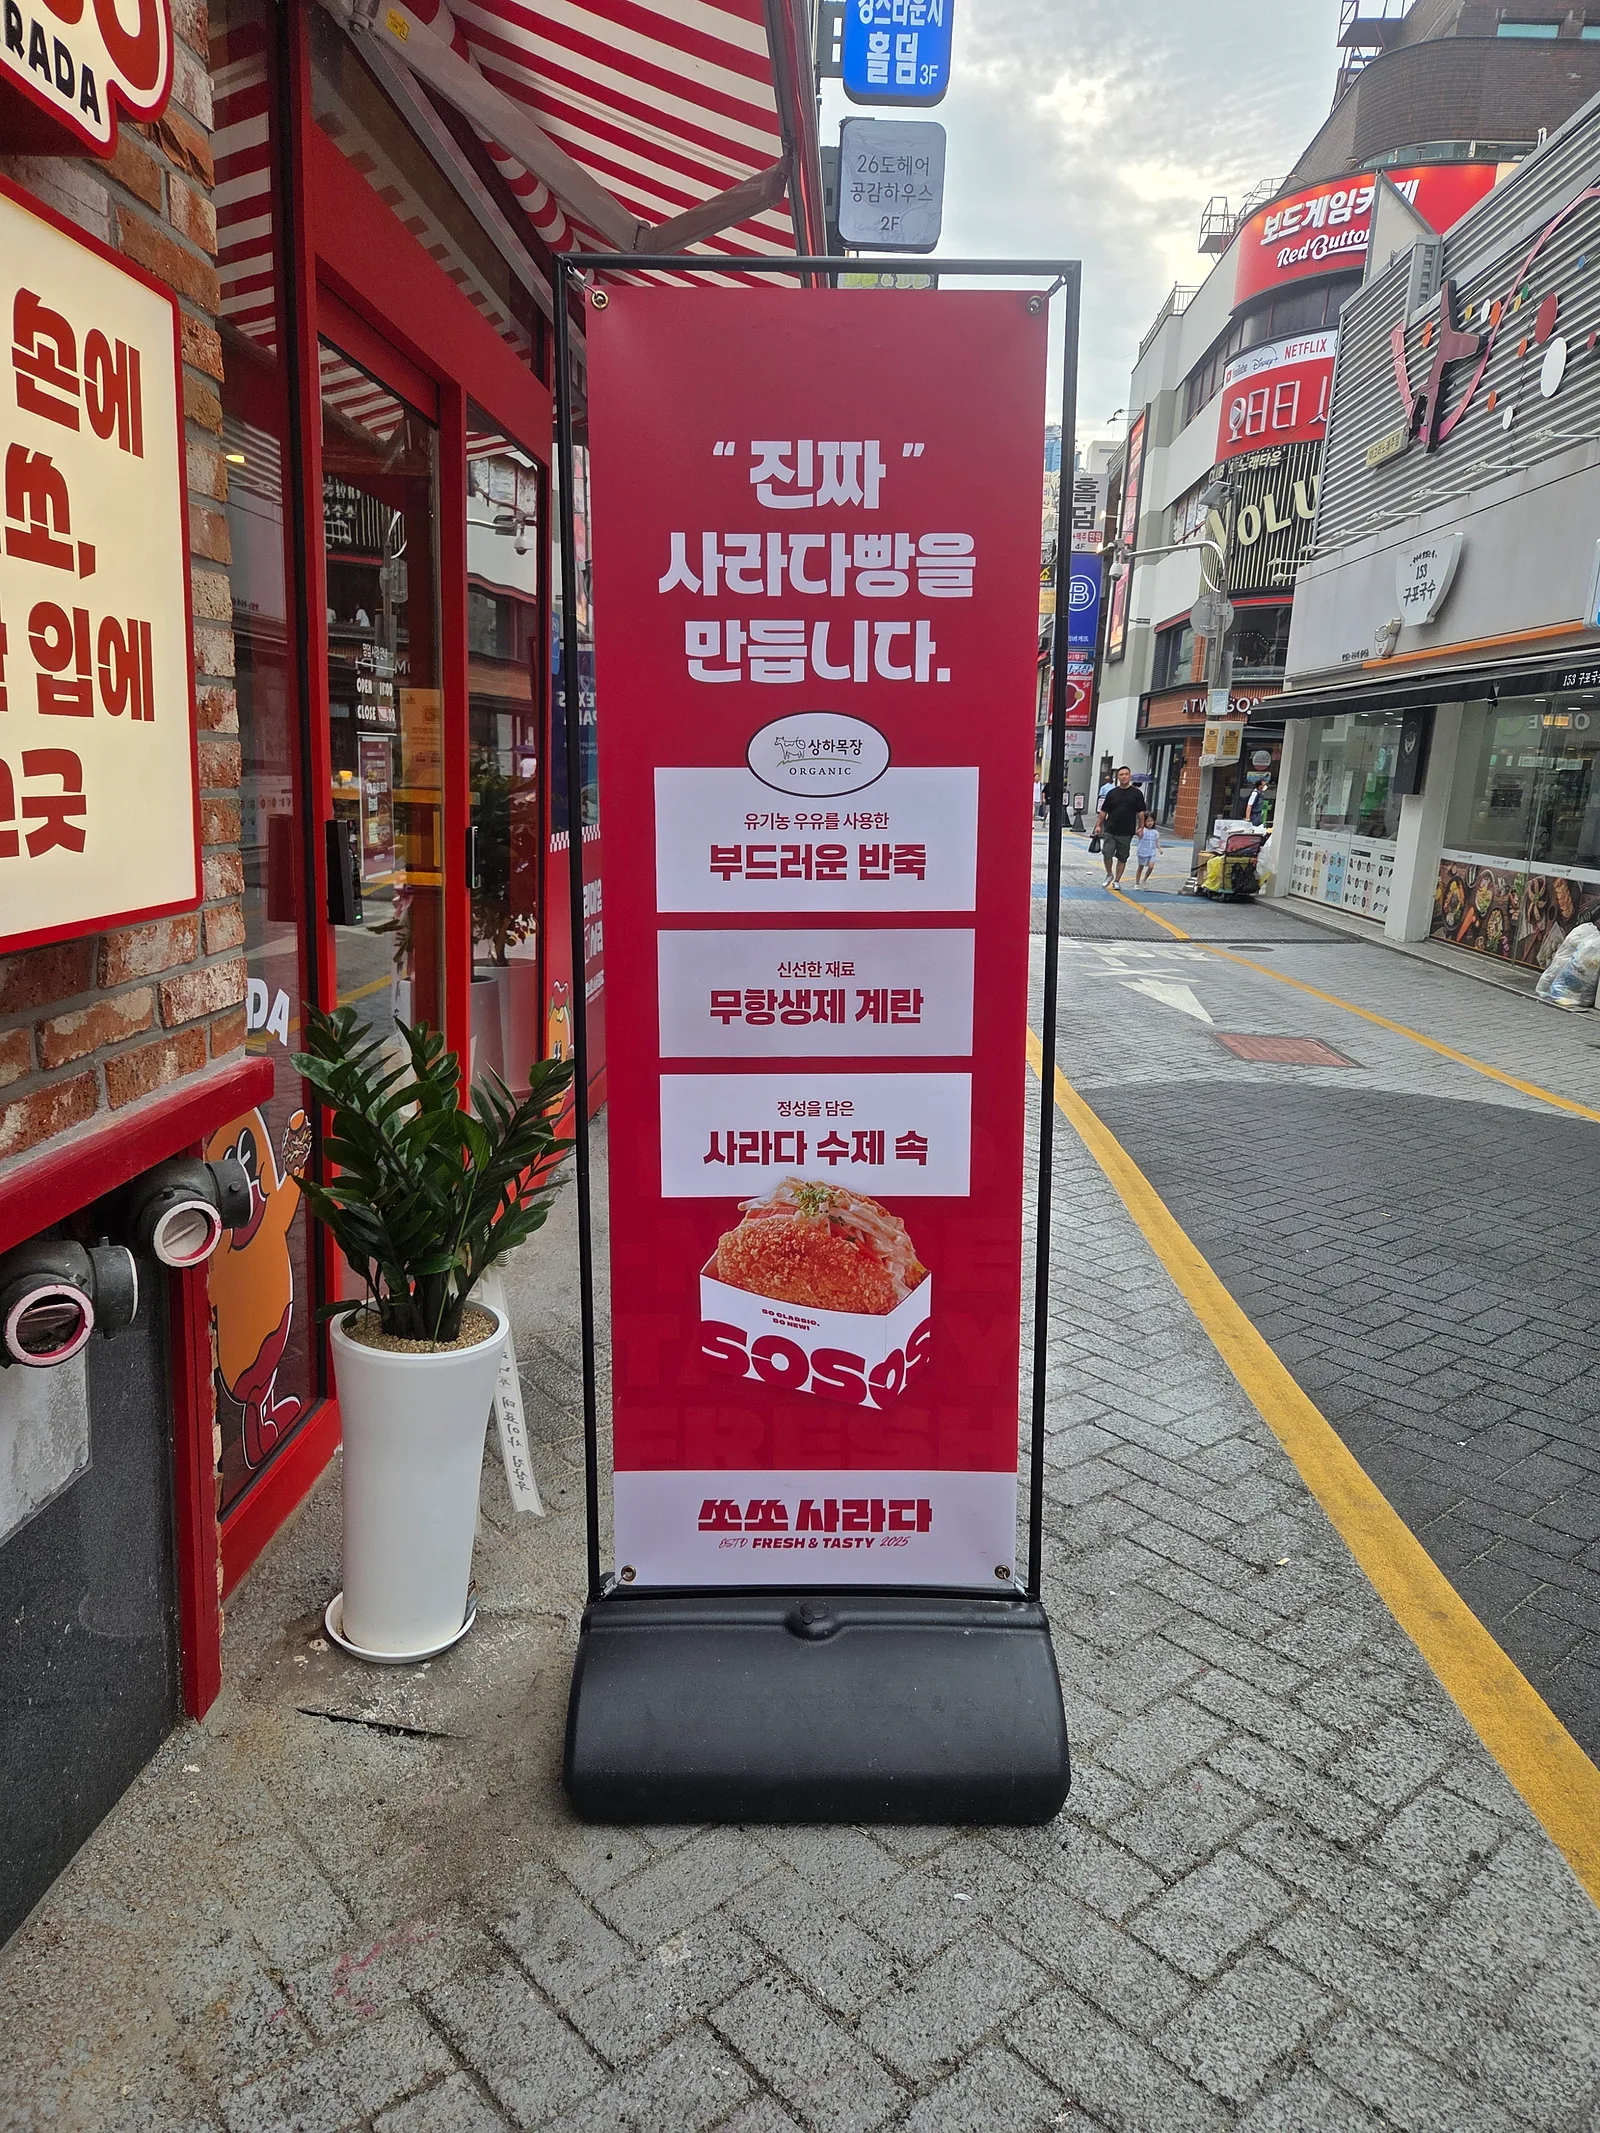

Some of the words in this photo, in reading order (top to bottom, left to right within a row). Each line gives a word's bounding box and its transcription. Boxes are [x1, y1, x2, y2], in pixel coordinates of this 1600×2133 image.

[866, 31, 918, 85] 홀덤
[919, 64, 939, 85] 3F
[857, 154, 930, 176] 26도헤어
[850, 182, 933, 203] 공감하우스
[880, 216, 900, 231] 2F
[1284, 338, 1328, 360] NETFLIX
[10, 286, 145, 460] 손에
[658, 532, 977, 598] 사라다빵을
[1403, 579, 1436, 607] 구포국수
[27, 601, 155, 722] 입에
[685, 619, 951, 683] 만듭니다.
[356, 677, 373, 694] OPEN
[1562, 673, 1577, 686] 153
[1579, 670, 1600, 685] 구포국
[357, 704, 381, 721] CLOSE
[808, 738, 863, 756] 상하목장
[789, 767, 852, 776] ORGANIC
[744, 813, 790, 830] 유기농
[793, 813, 840, 830] 우유를
[843, 812, 890, 830] 사용한
[709, 843, 848, 882] 부드러운
[857, 843, 927, 881] 반죽
[777, 961, 822, 978] 신선한
[825, 961, 856, 978] 재료
[709, 988, 847, 1026] 무항생제
[855, 988, 925, 1024] 계란
[777, 1101, 822, 1117] 정성을
[825, 1101, 855, 1117] 담은
[703, 1130, 808, 1165] 사라다
[816, 1130, 885, 1166] 수제
[894, 1130, 929, 1166] 속
[761, 1308, 775, 1317] SO
[772, 1318, 786, 1326] SO
[698, 1499, 789, 1531] 쏘쏘
[795, 1498, 933, 1533] 사라다
[752, 1537, 805, 1549] FRESH
[807, 1537, 818, 1549] &
[822, 1537, 875, 1549] TASTY
[879, 1535, 912, 1548] 2025
